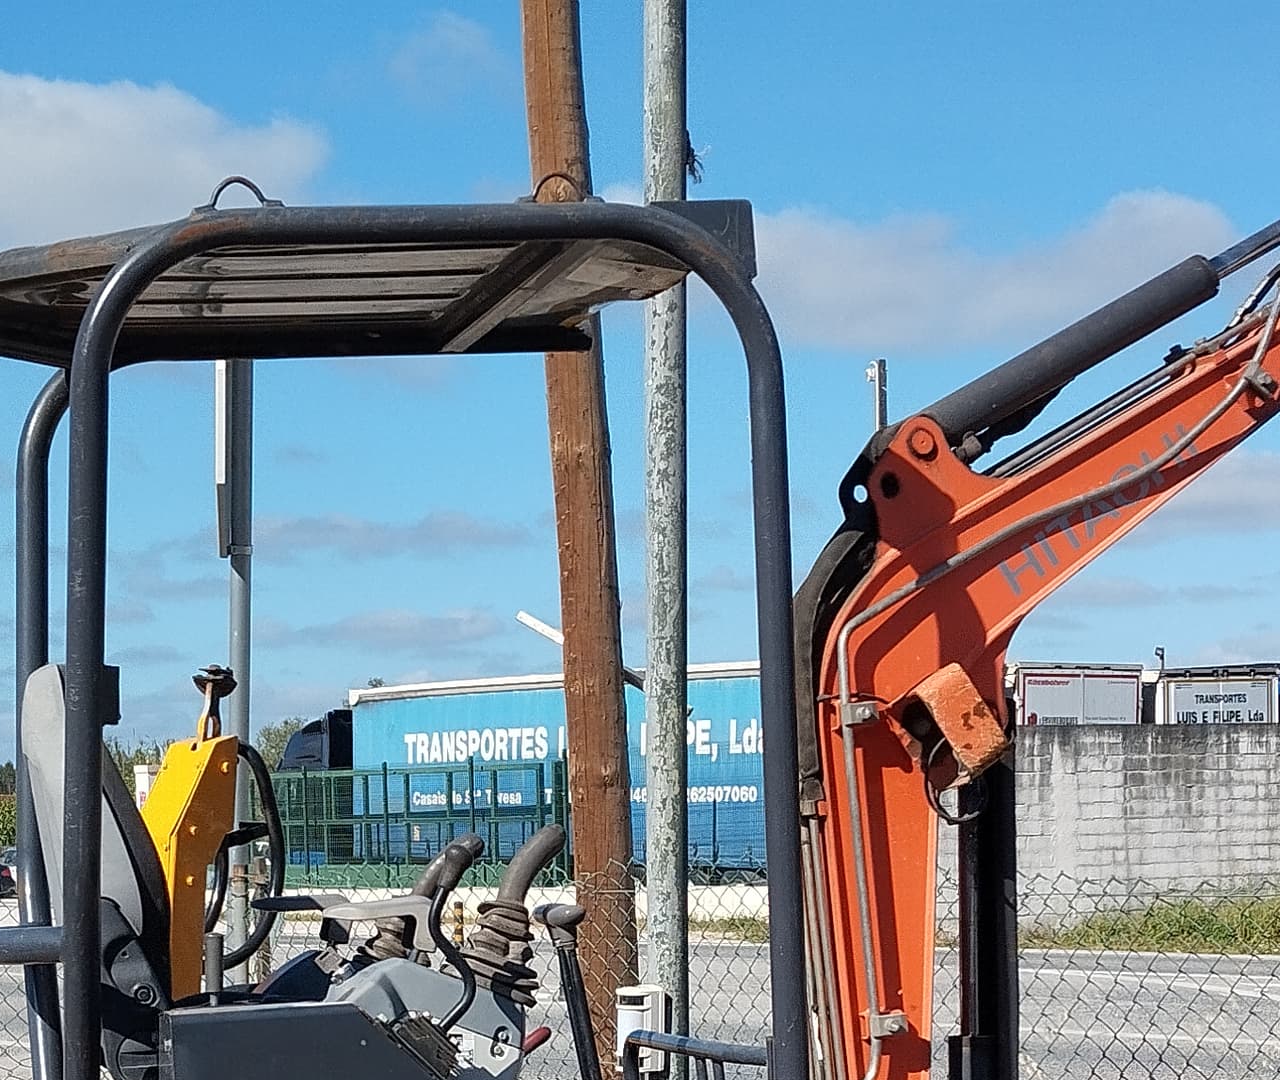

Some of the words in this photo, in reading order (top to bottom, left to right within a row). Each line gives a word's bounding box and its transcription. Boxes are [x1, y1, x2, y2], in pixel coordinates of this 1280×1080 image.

[998, 423, 1199, 597] HITACHI
[1194, 693, 1247, 704] TRANSPORTES
[1176, 711, 1198, 723] LUIS
[1202, 711, 1209, 723] E
[1248, 709, 1264, 722] Lda
[404, 727, 548, 764] TRANSPORTES
[412, 790, 447, 806] Casais
